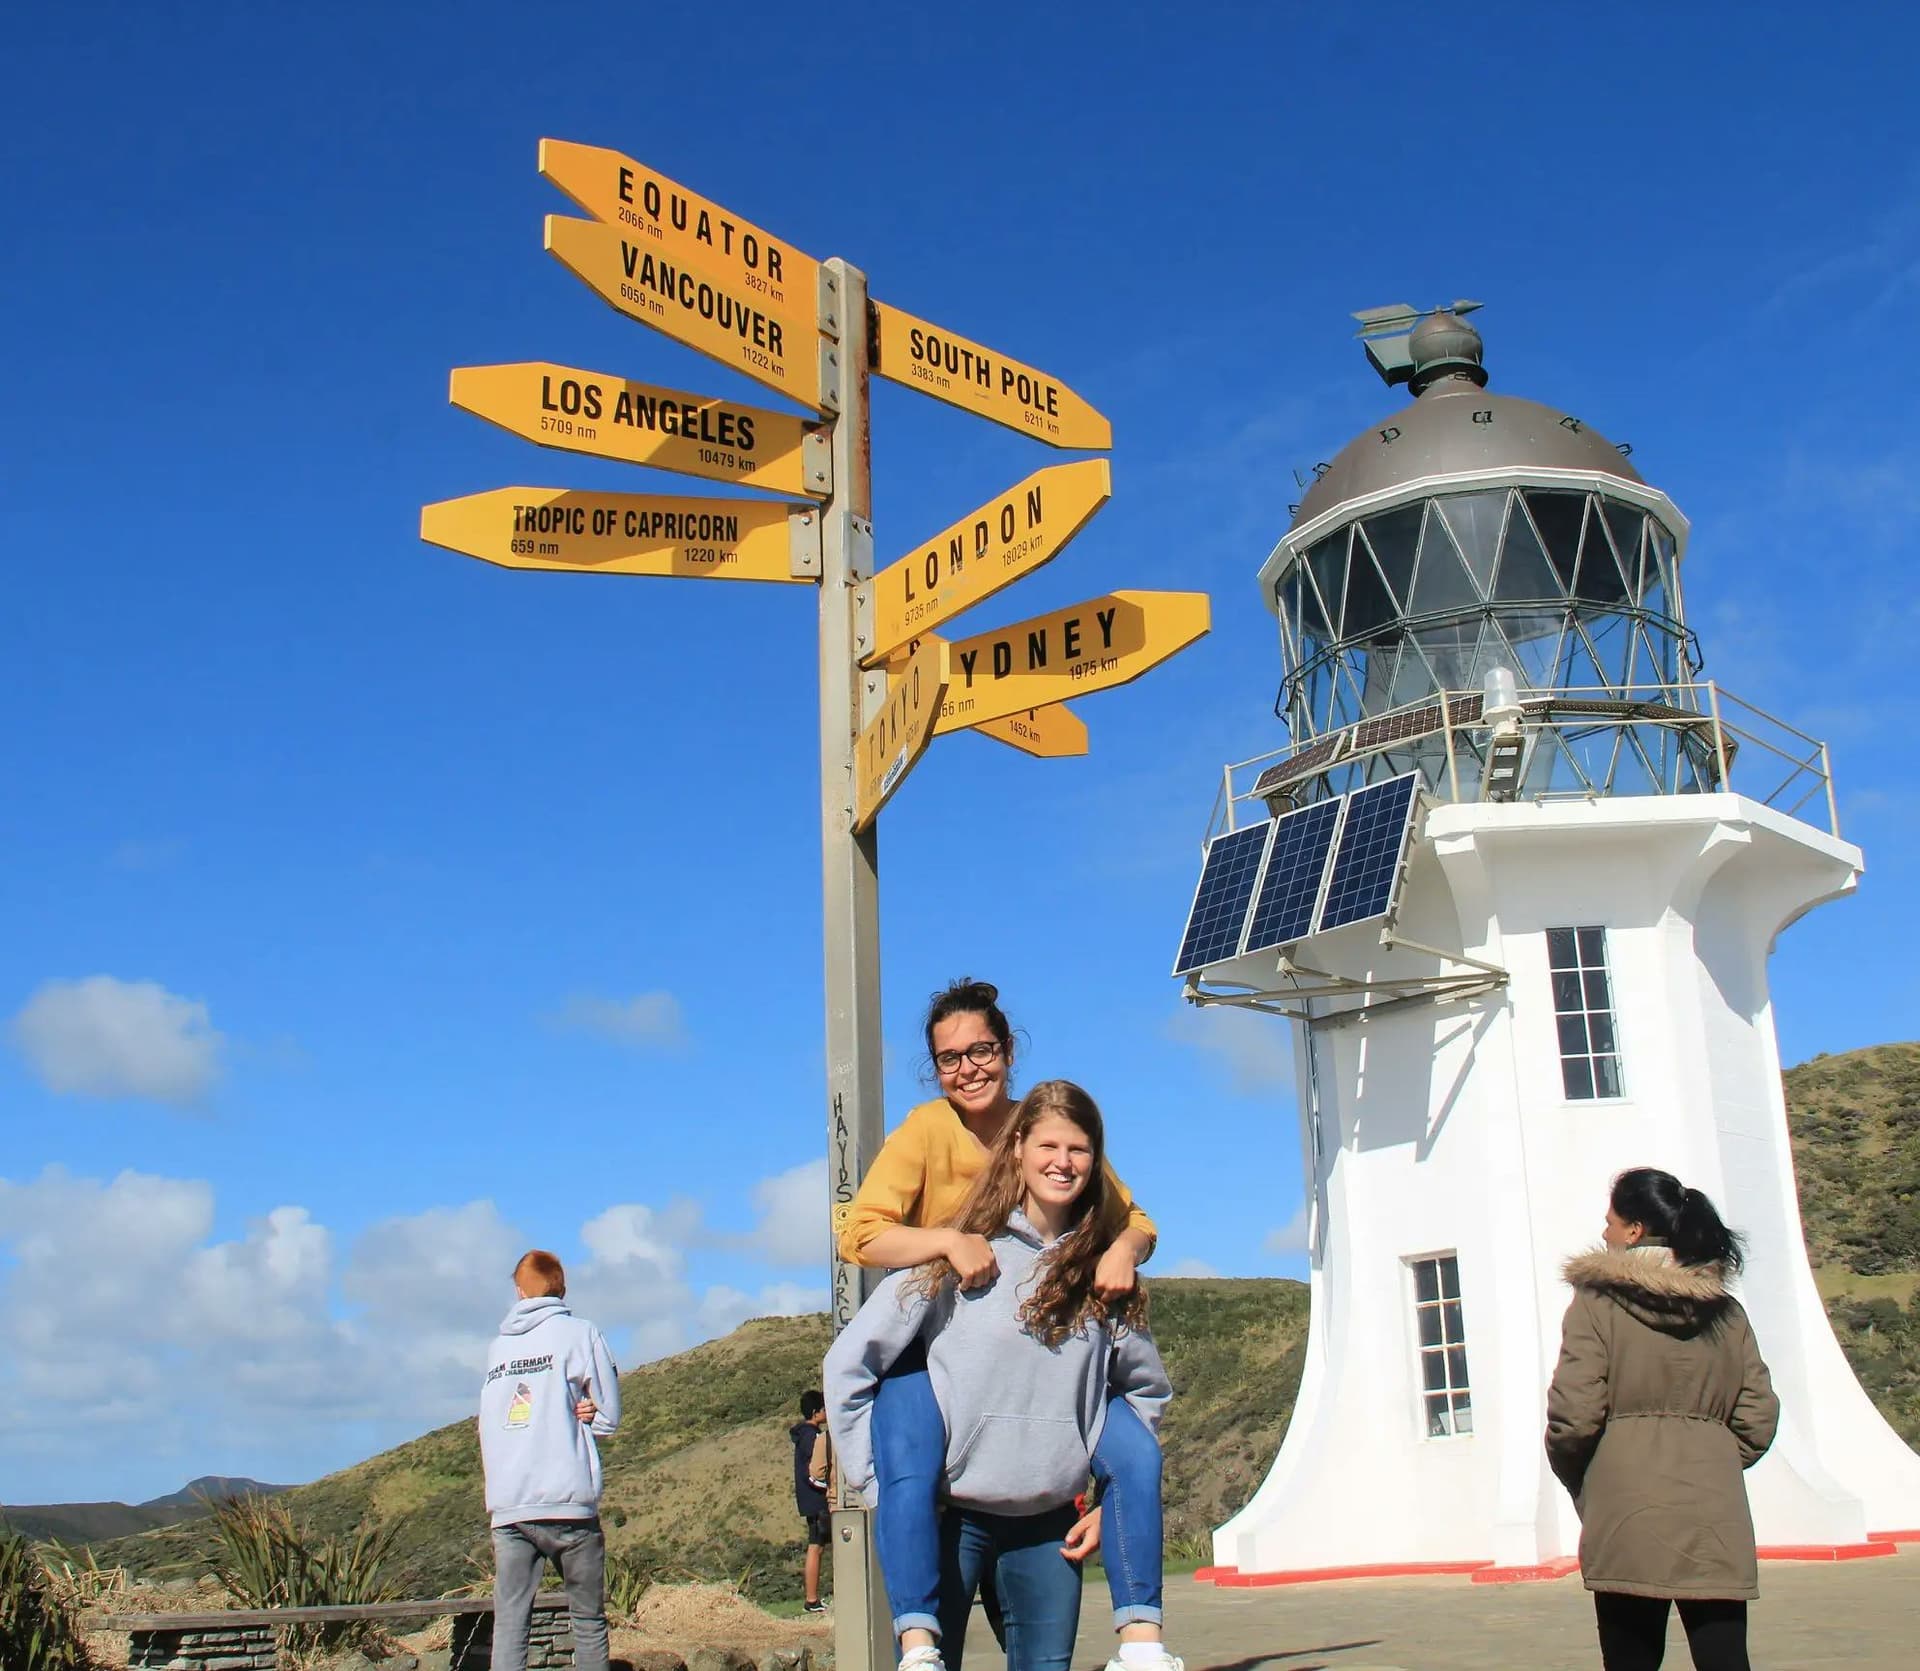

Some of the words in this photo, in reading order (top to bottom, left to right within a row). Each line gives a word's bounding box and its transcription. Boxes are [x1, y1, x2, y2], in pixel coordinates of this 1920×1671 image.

[618, 206, 645, 231] 2066
[647, 223, 663, 241] nm
[618, 166, 784, 284] EQUATOR
[620, 283, 646, 307] 6059
[649, 299, 665, 316] nm
[621, 240, 784, 358] VANCOUVER
[744, 272, 768, 295] 3827
[770, 284, 784, 304] km
[742, 346, 769, 370] 11222
[771, 354, 785, 378] km
[910, 328, 991, 389] SOUTH
[1001, 366, 1059, 418] POLE
[911, 363, 935, 382] 3383
[936, 376, 951, 389] nm
[540, 416, 573, 435] 5709
[577, 425, 597, 440] nm
[542, 375, 603, 420] LOS
[613, 391, 755, 451] ANGELES
[1024, 410, 1043, 429] 6211
[1047, 419, 1060, 435] km
[698, 448, 735, 468] 10479
[738, 455, 756, 473] km
[513, 505, 585, 535] TROPIC
[592, 508, 617, 536] OF
[624, 510, 738, 542] CAPRICORN
[511, 538, 534, 554] 659
[539, 543, 559, 555] nm
[684, 547, 715, 562] 1220
[719, 550, 738, 563] km
[905, 485, 1042, 604] LONDON
[1002, 540, 1028, 568] 18029
[1030, 534, 1043, 552] km
[904, 603, 924, 626] 9735
[926, 597, 938, 613] nm
[959, 607, 1116, 689] YDNEY
[1069, 660, 1097, 681] 1975
[1100, 656, 1118, 673] km
[869, 665, 920, 773] TOKYO
[937, 700, 955, 720] 66
[958, 698, 975, 713] nm
[1009, 719, 1028, 738] 1452
[1029, 727, 1041, 744] km
[510, 1354, 554, 1369] GERMANY
